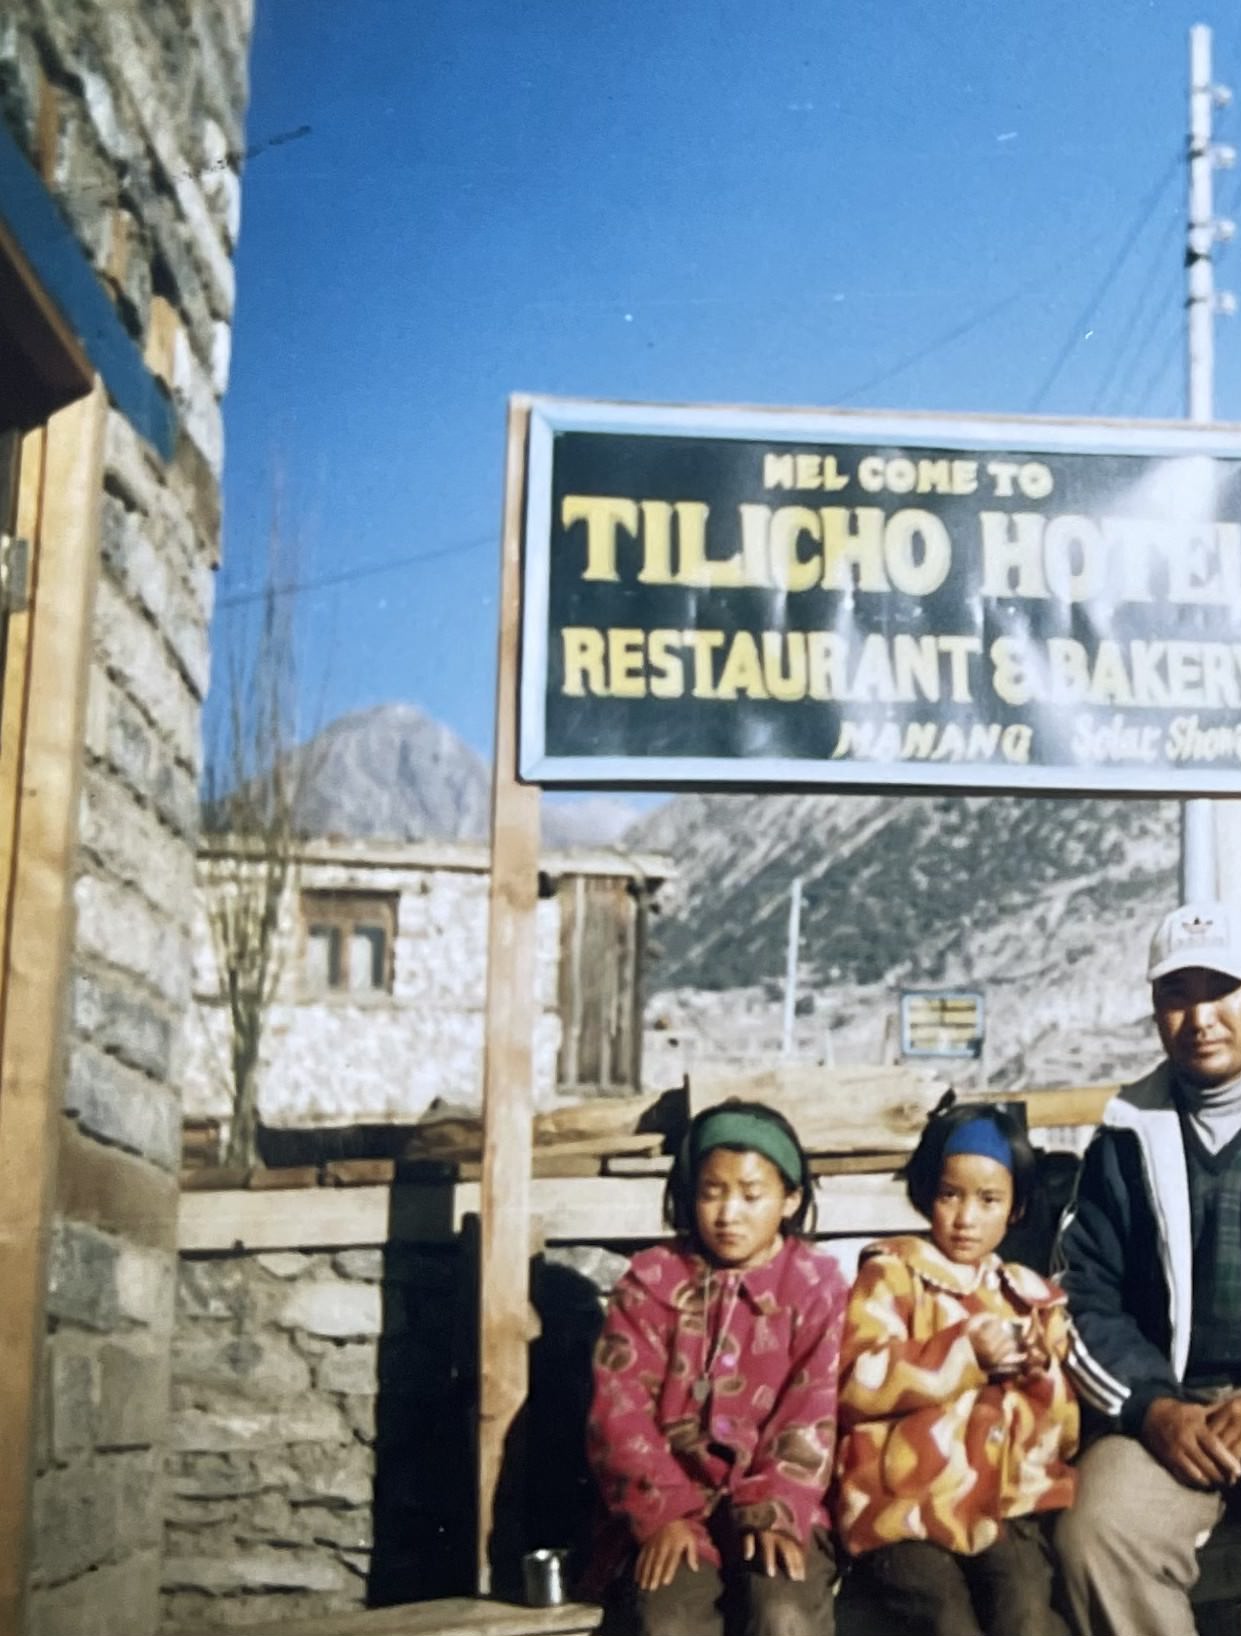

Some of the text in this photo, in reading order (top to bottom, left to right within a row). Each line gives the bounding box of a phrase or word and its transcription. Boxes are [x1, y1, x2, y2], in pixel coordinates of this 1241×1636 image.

[857, 455, 978, 496] COME
[987, 461, 1055, 499] TO
[561, 495, 953, 597] TILICHO
[561, 627, 985, 702] RESTAURANT
